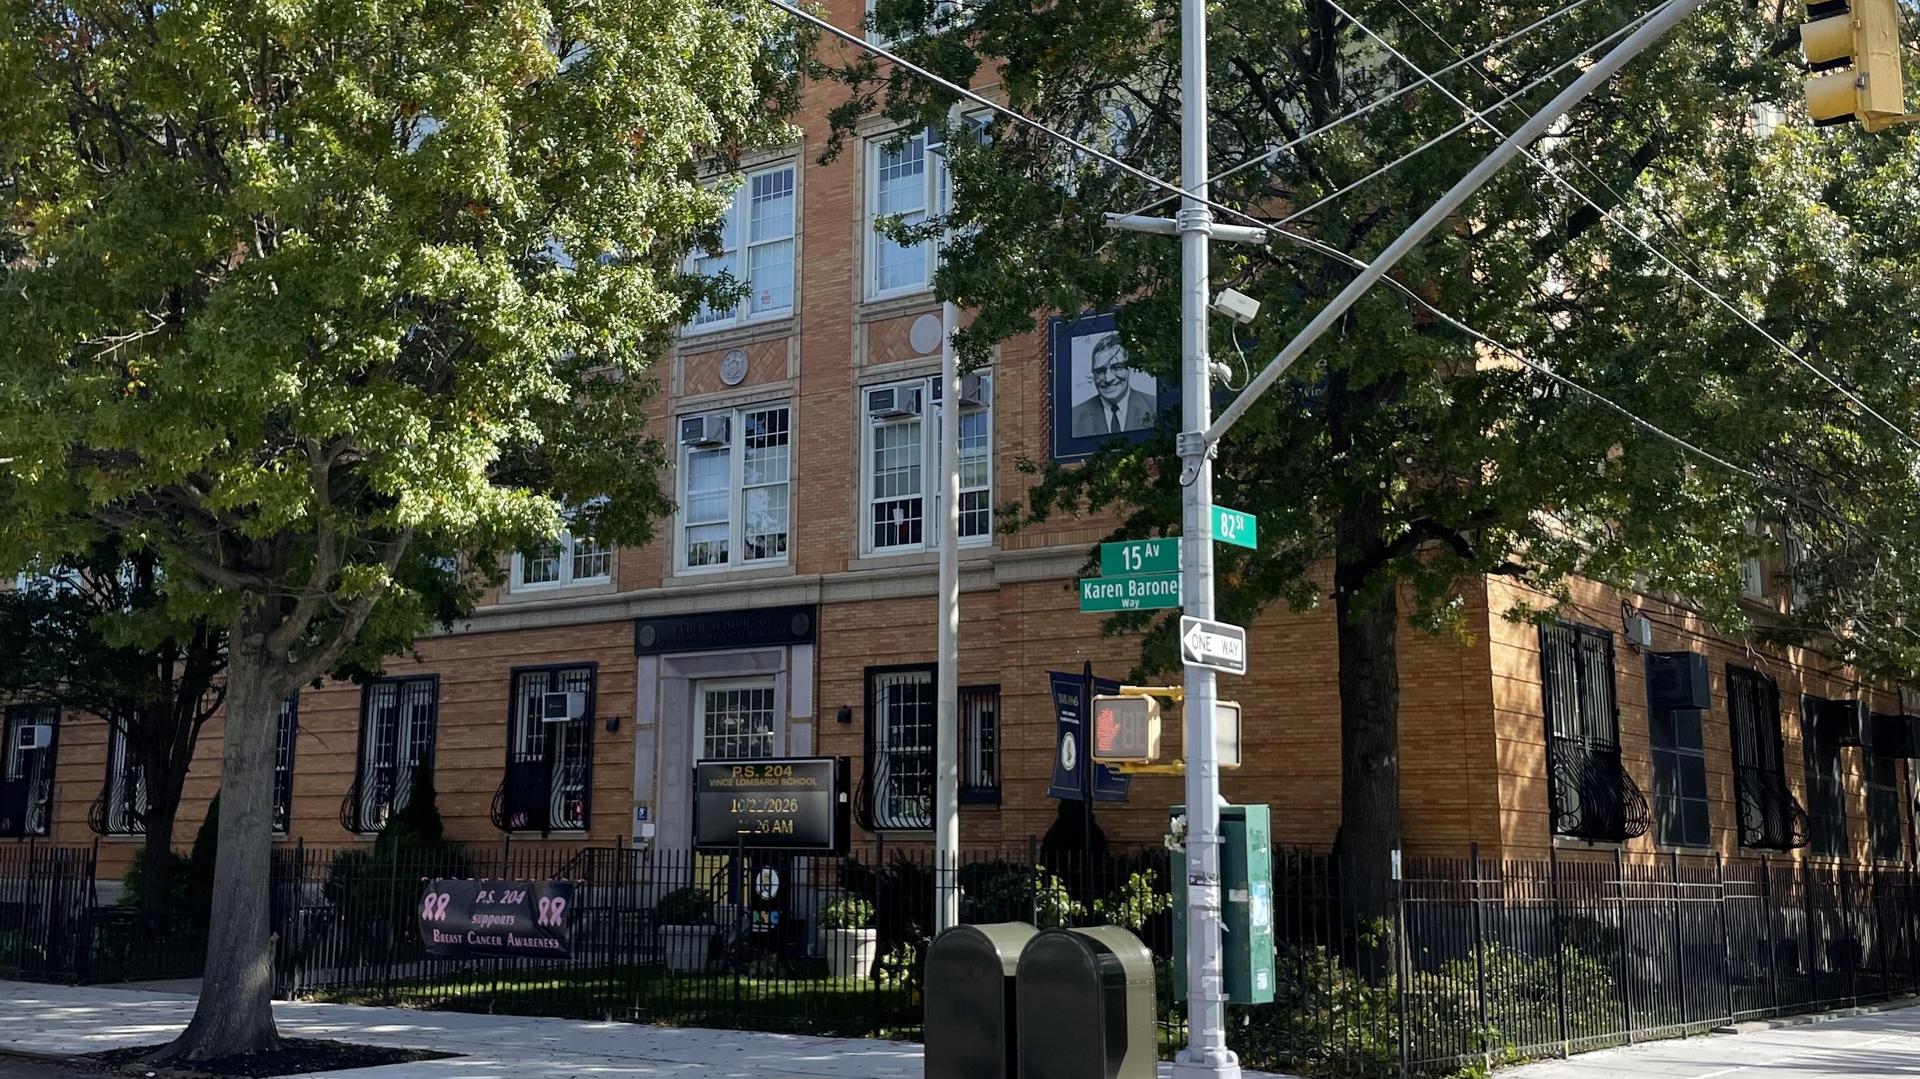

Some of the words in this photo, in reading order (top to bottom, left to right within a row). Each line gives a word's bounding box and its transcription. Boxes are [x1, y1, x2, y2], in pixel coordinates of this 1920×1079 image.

[1221, 512, 1235, 539] 82
[1122, 546, 1142, 571] 15
[1145, 543, 1160, 558] Av
[1084, 582, 1124, 600] Karen
[1128, 580, 1178, 597] Barone
[1121, 599, 1140, 609] Way
[1191, 633, 1212, 653] ONE
[1221, 640, 1240, 656] WAY
[732, 765, 760, 778] P.S.
[764, 765, 793, 777] 204
[709, 779, 734, 787] VINCE
[735, 778, 779, 787] LOMBARDI
[781, 777, 818, 786] SCHOOL
[731, 798, 798, 813] 10/2/2026
[771, 820, 793, 834] AM
[475, 890, 496, 904] P.S.
[500, 889, 526, 904] 204
[471, 914, 516, 928] supports
